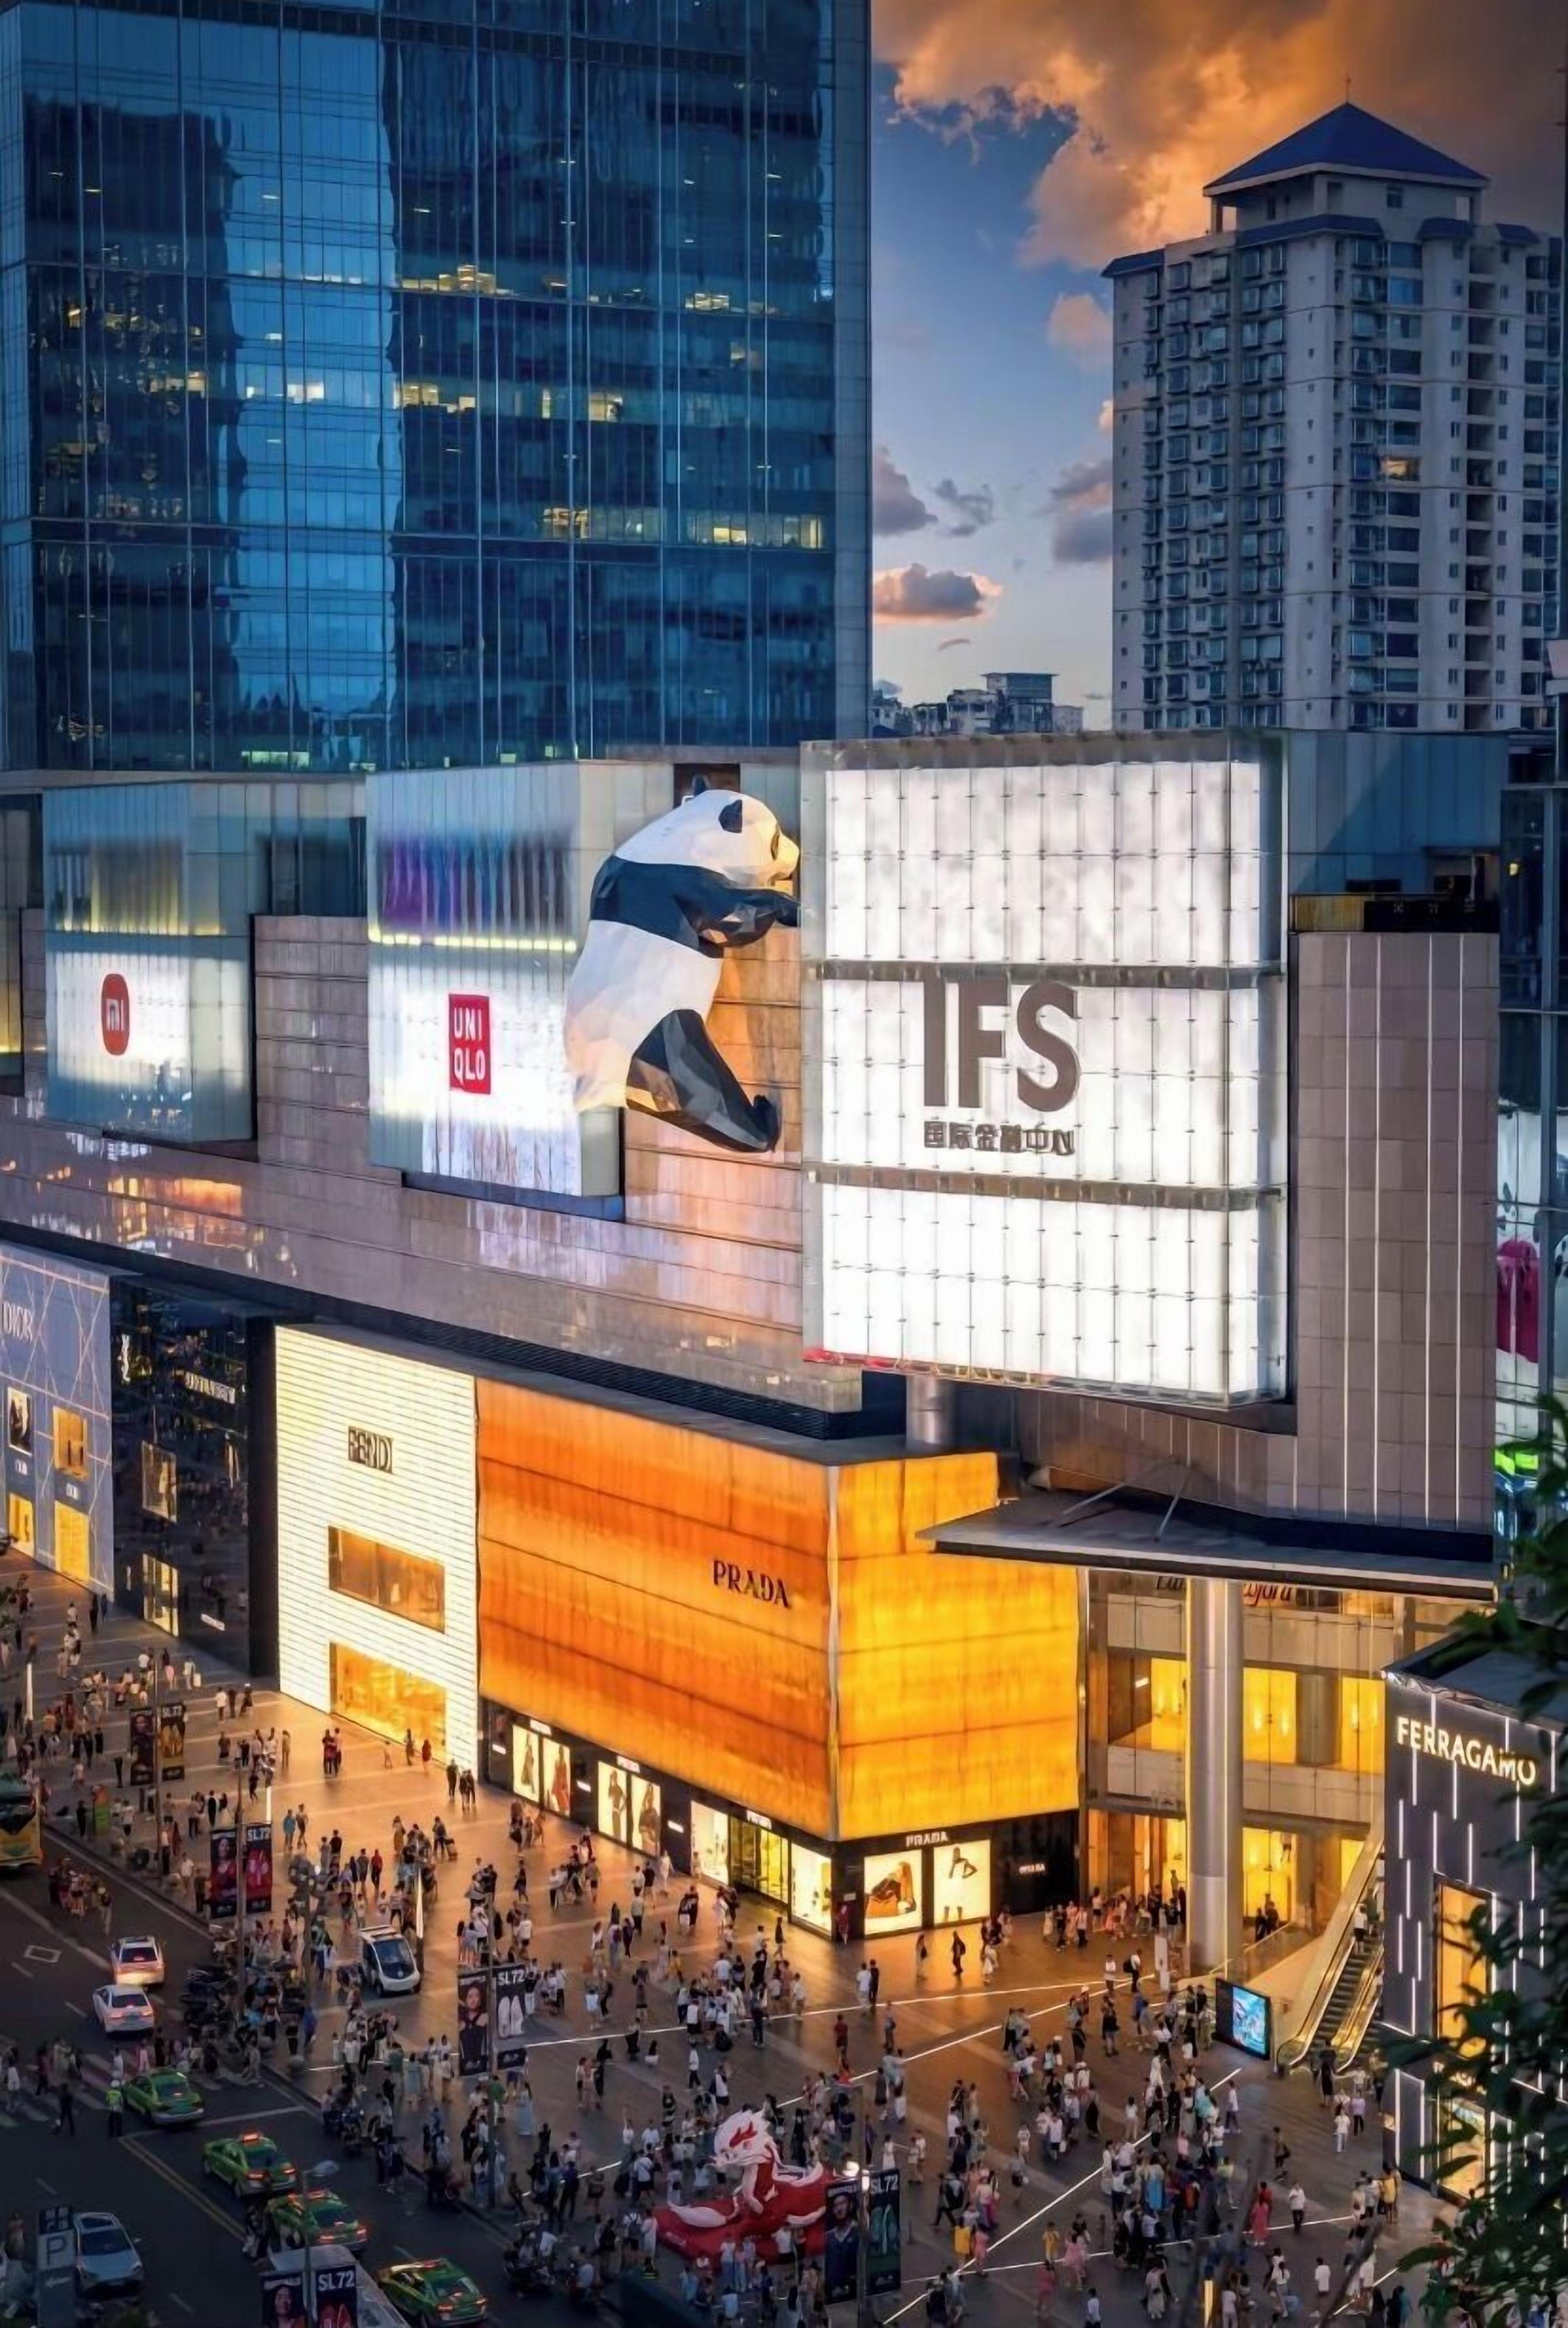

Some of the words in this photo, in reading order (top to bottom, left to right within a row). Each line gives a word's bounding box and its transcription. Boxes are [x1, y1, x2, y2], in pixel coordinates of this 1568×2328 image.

[454, 1007, 482, 1040] UNI
[924, 972, 1081, 1112] IFS
[454, 1047, 486, 1086] QLO
[348, 1426, 393, 1474] FENDI
[713, 1560, 792, 1608] PRADA
[1397, 1716, 1536, 1785] FERRAGAMO
[906, 1831, 948, 1847] PRADA
[46, 2235, 68, 2265] P
[318, 2271, 355, 2291] SL72
